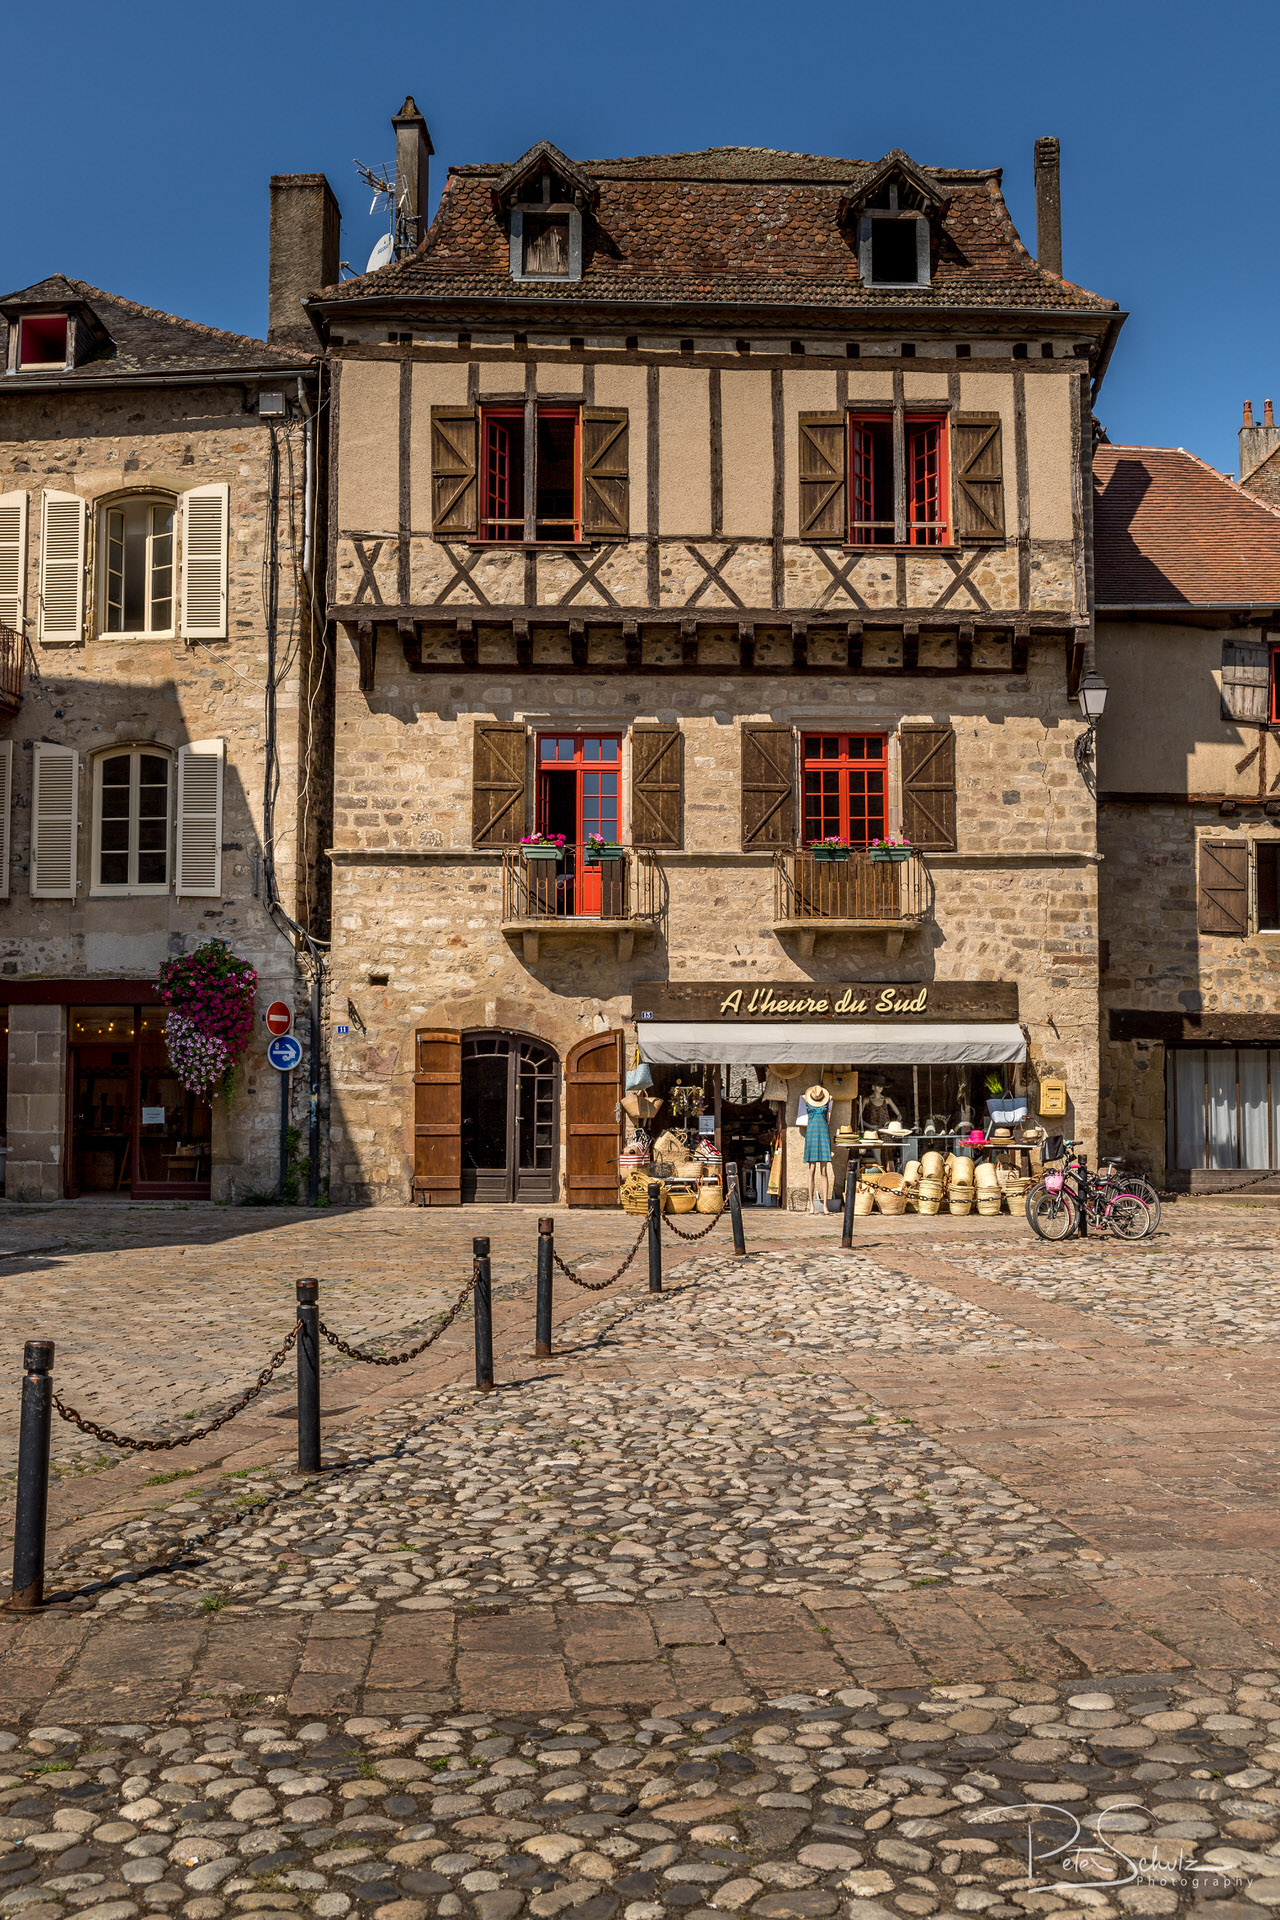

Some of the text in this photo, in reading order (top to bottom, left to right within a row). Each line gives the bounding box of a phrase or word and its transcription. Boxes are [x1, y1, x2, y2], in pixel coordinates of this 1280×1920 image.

[720, 989, 743, 1013] A
[747, 987, 828, 1013] l'heure
[834, 988, 868, 1013] du
[875, 988, 928, 1013] Sud
